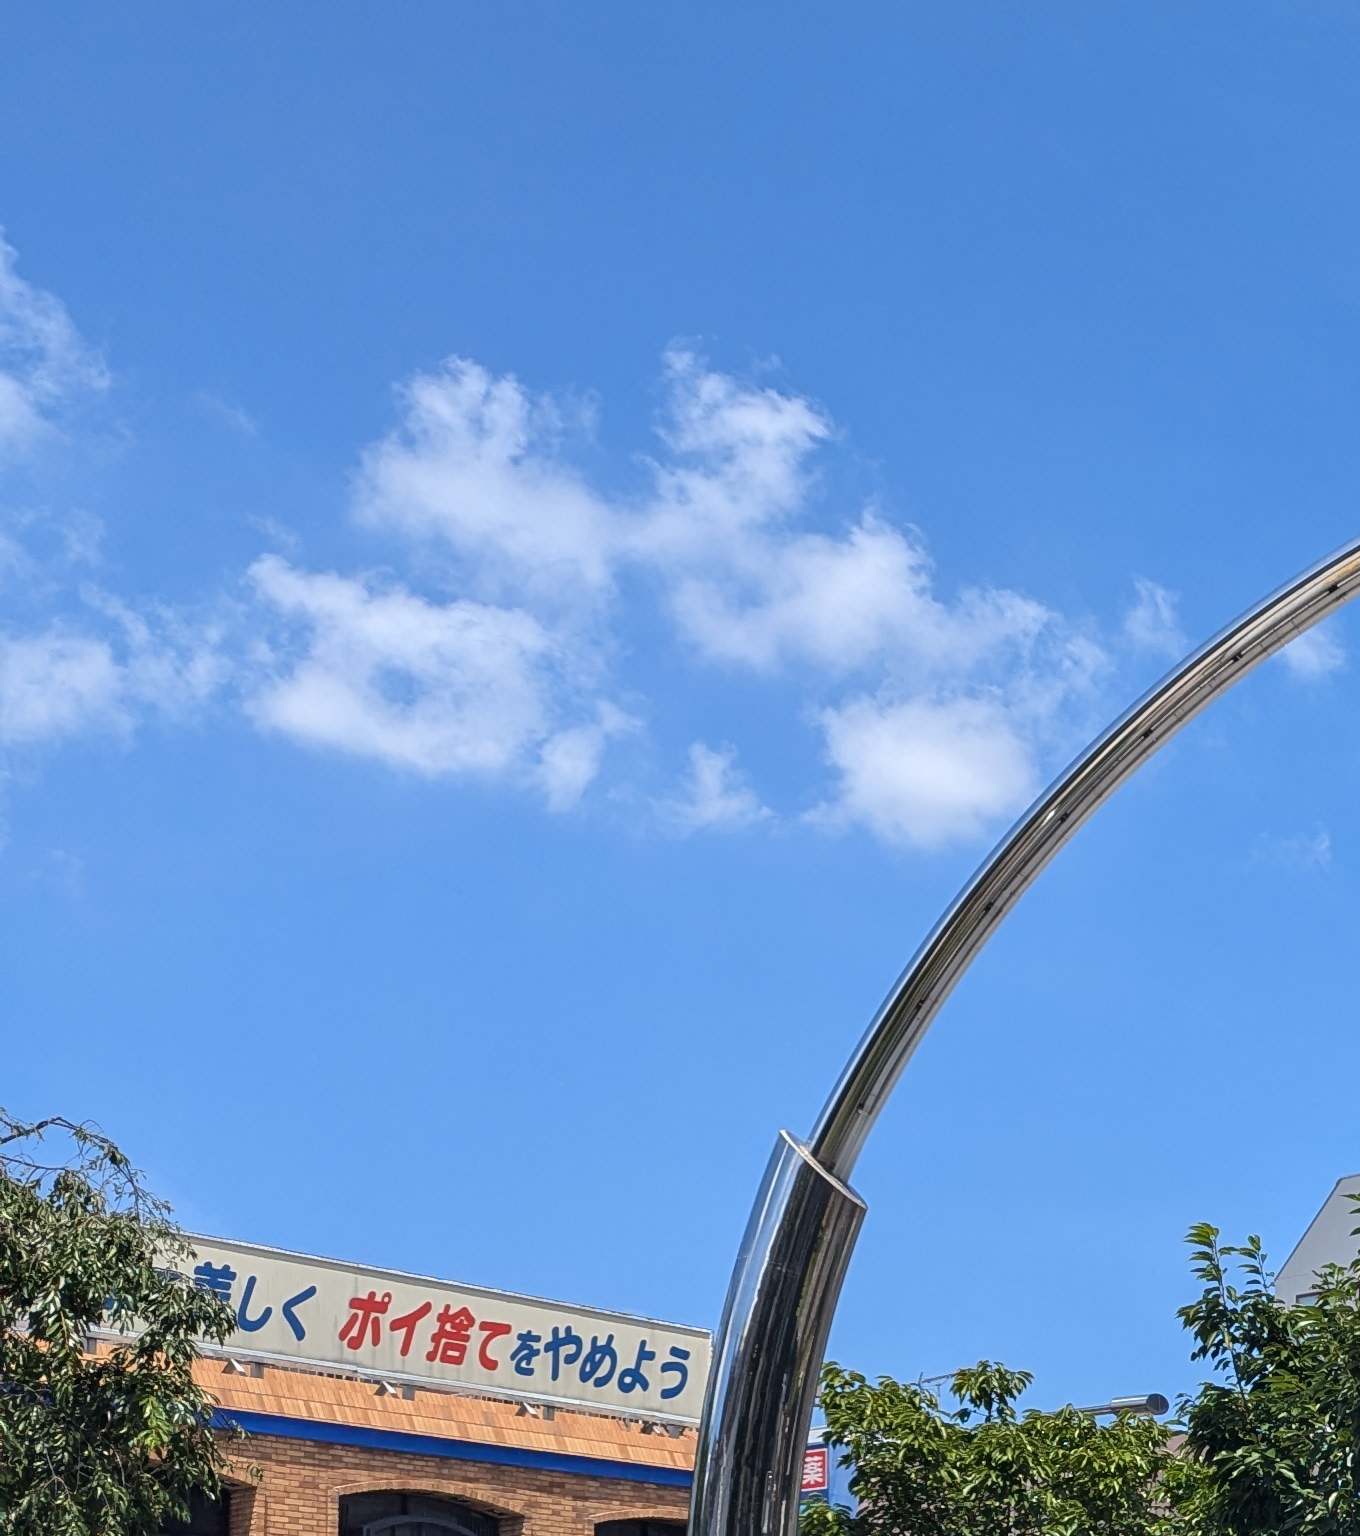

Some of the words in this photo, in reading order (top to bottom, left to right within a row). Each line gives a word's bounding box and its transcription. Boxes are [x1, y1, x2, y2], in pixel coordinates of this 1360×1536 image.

[338, 1289, 692, 1400] ポイ捨てをやめよう
[802, 1452, 824, 1485] 薬
